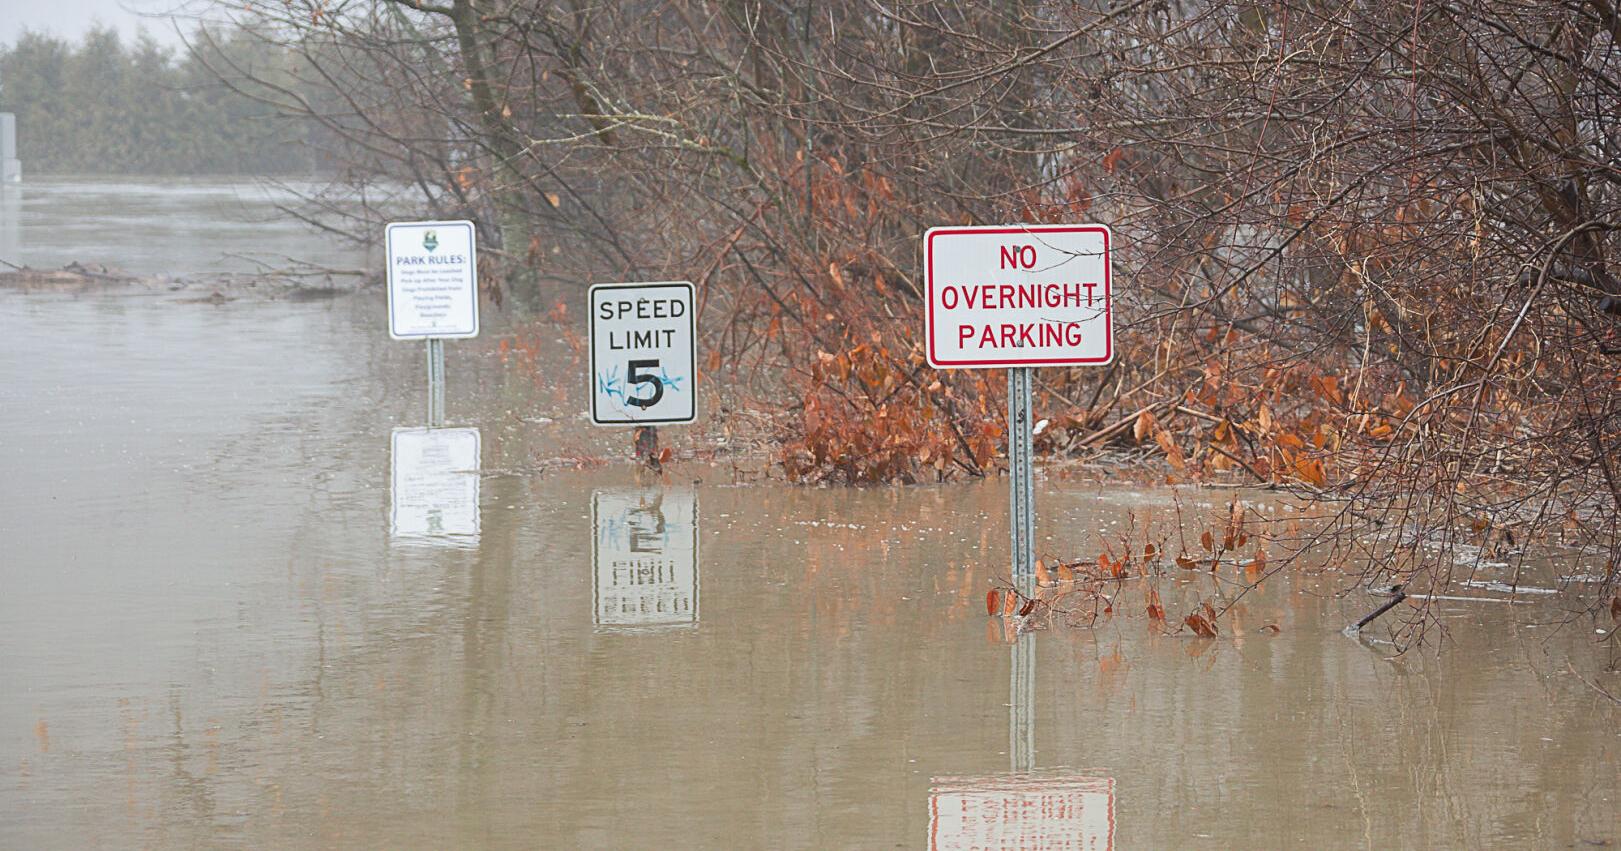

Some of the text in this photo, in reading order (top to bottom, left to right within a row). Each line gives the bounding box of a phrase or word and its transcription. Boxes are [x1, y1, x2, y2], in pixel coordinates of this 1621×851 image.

[397, 255, 466, 265] PARK RULES:
[1000, 245, 1037, 269] NO
[942, 283, 1097, 310] OVERNIGHT
[600, 300, 685, 320] SPEED
[610, 330, 675, 349] LIMIT
[959, 323, 1081, 349] PARKING
[627, 359, 664, 407] 5
